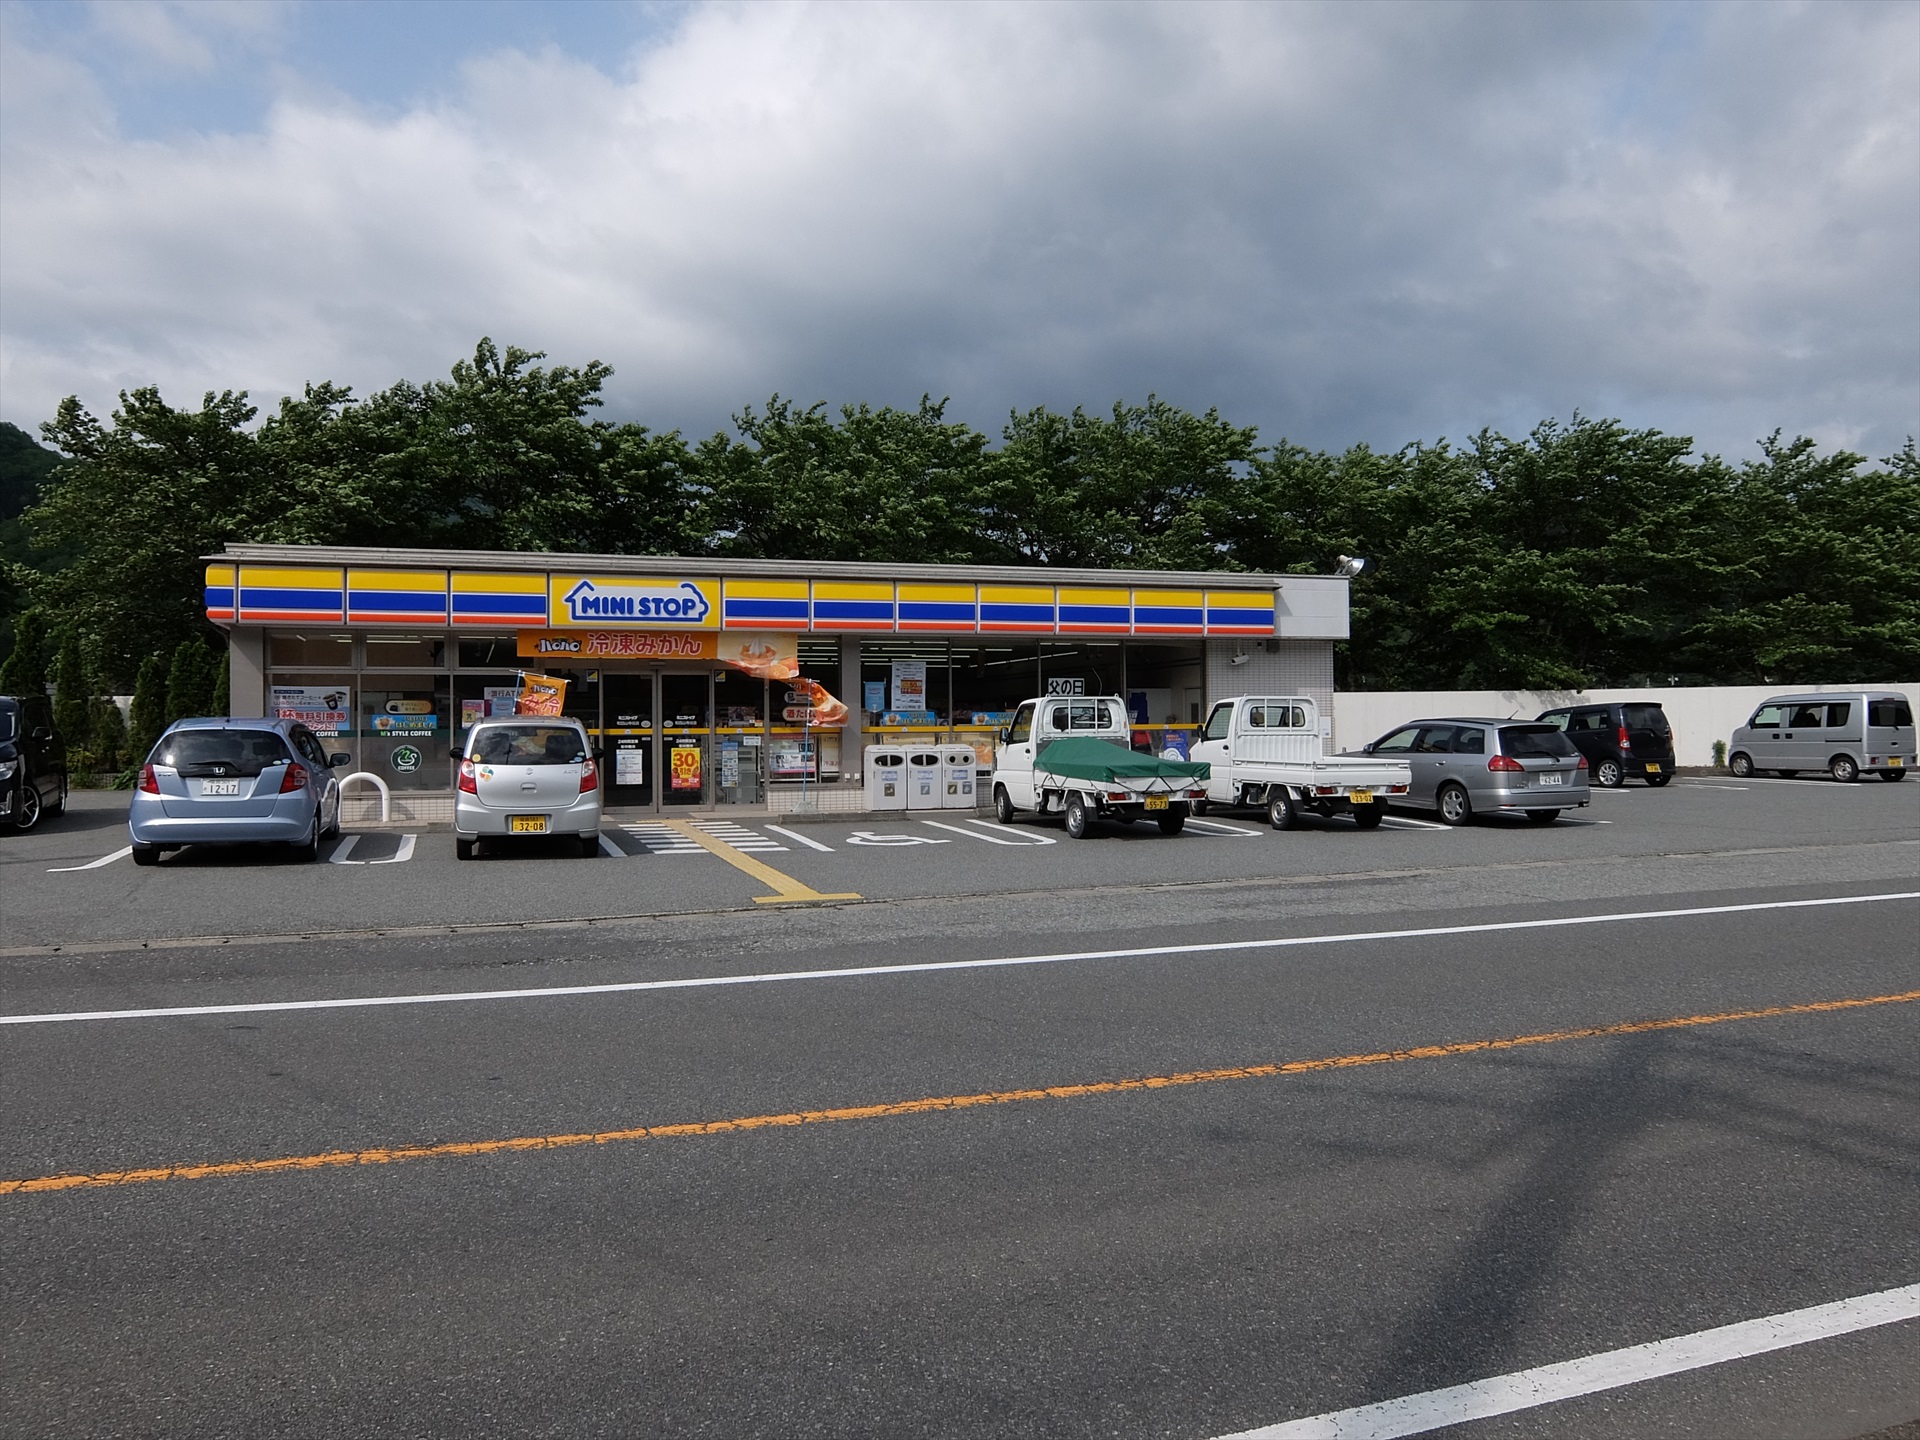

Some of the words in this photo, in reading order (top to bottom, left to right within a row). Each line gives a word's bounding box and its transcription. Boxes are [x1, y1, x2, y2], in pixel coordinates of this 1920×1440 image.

[581, 595, 633, 615] MINI
[638, 596, 697, 617] STOP
[587, 632, 702, 656] 冷凍みかん
[1049, 679, 1084, 696] 父の日
[672, 752, 697, 768] 30
[210, 784, 237, 793] 12-17
[1149, 800, 1168, 809] 55-73
[519, 822, 544, 831] 32-08
